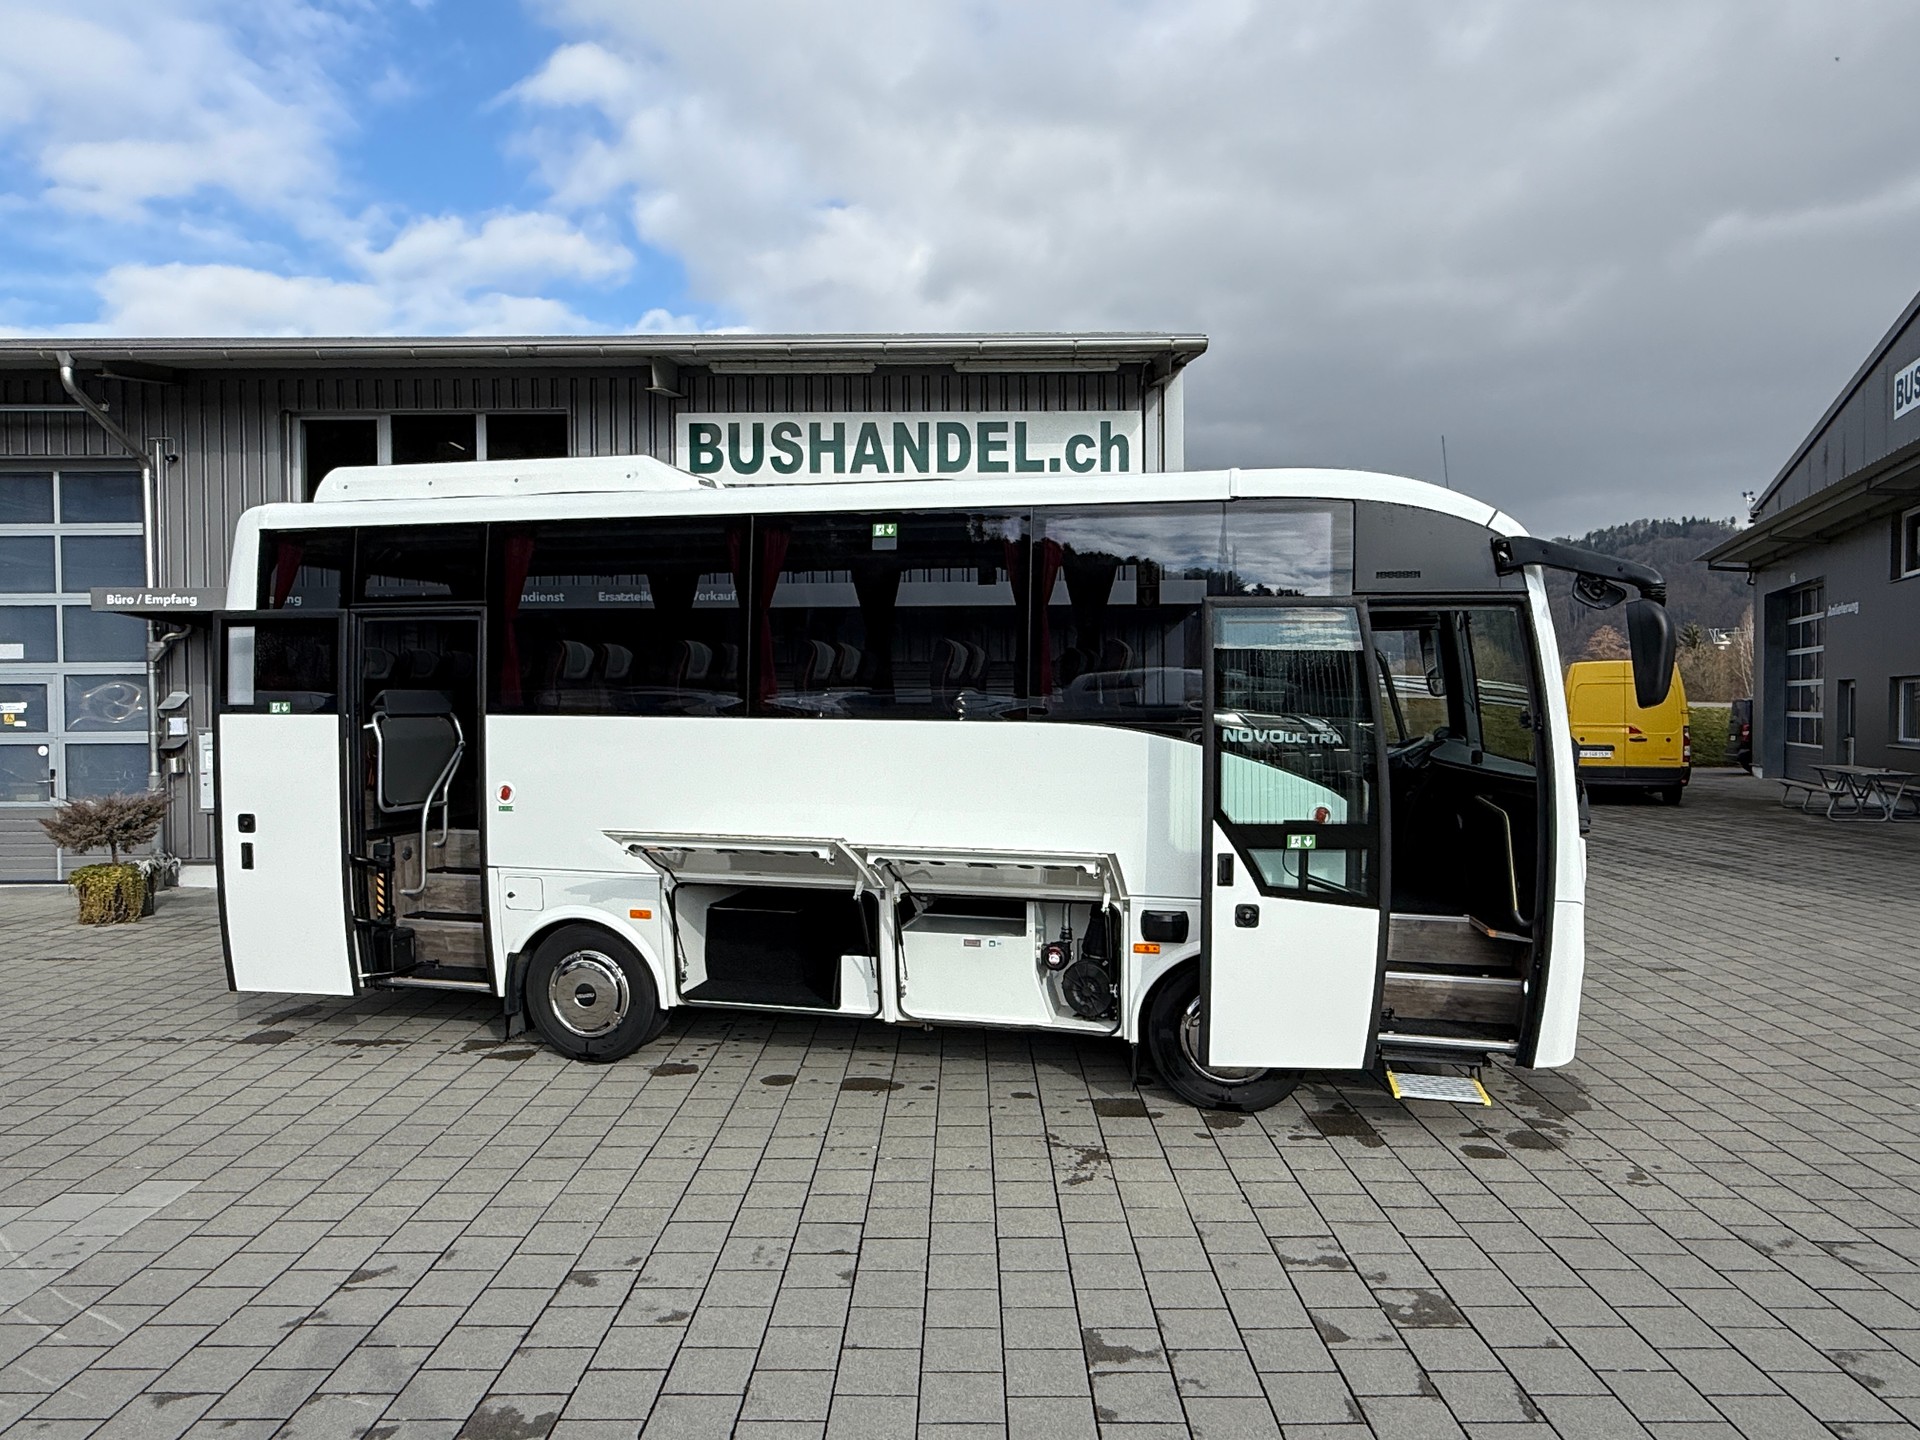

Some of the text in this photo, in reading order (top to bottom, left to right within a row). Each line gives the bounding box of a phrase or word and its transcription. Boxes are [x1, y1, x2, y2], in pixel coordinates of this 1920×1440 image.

[688, 421, 1130, 474] BUSHANDEL.ch
[106, 594, 135, 605] Büro
[144, 593, 198, 607] Empfang
